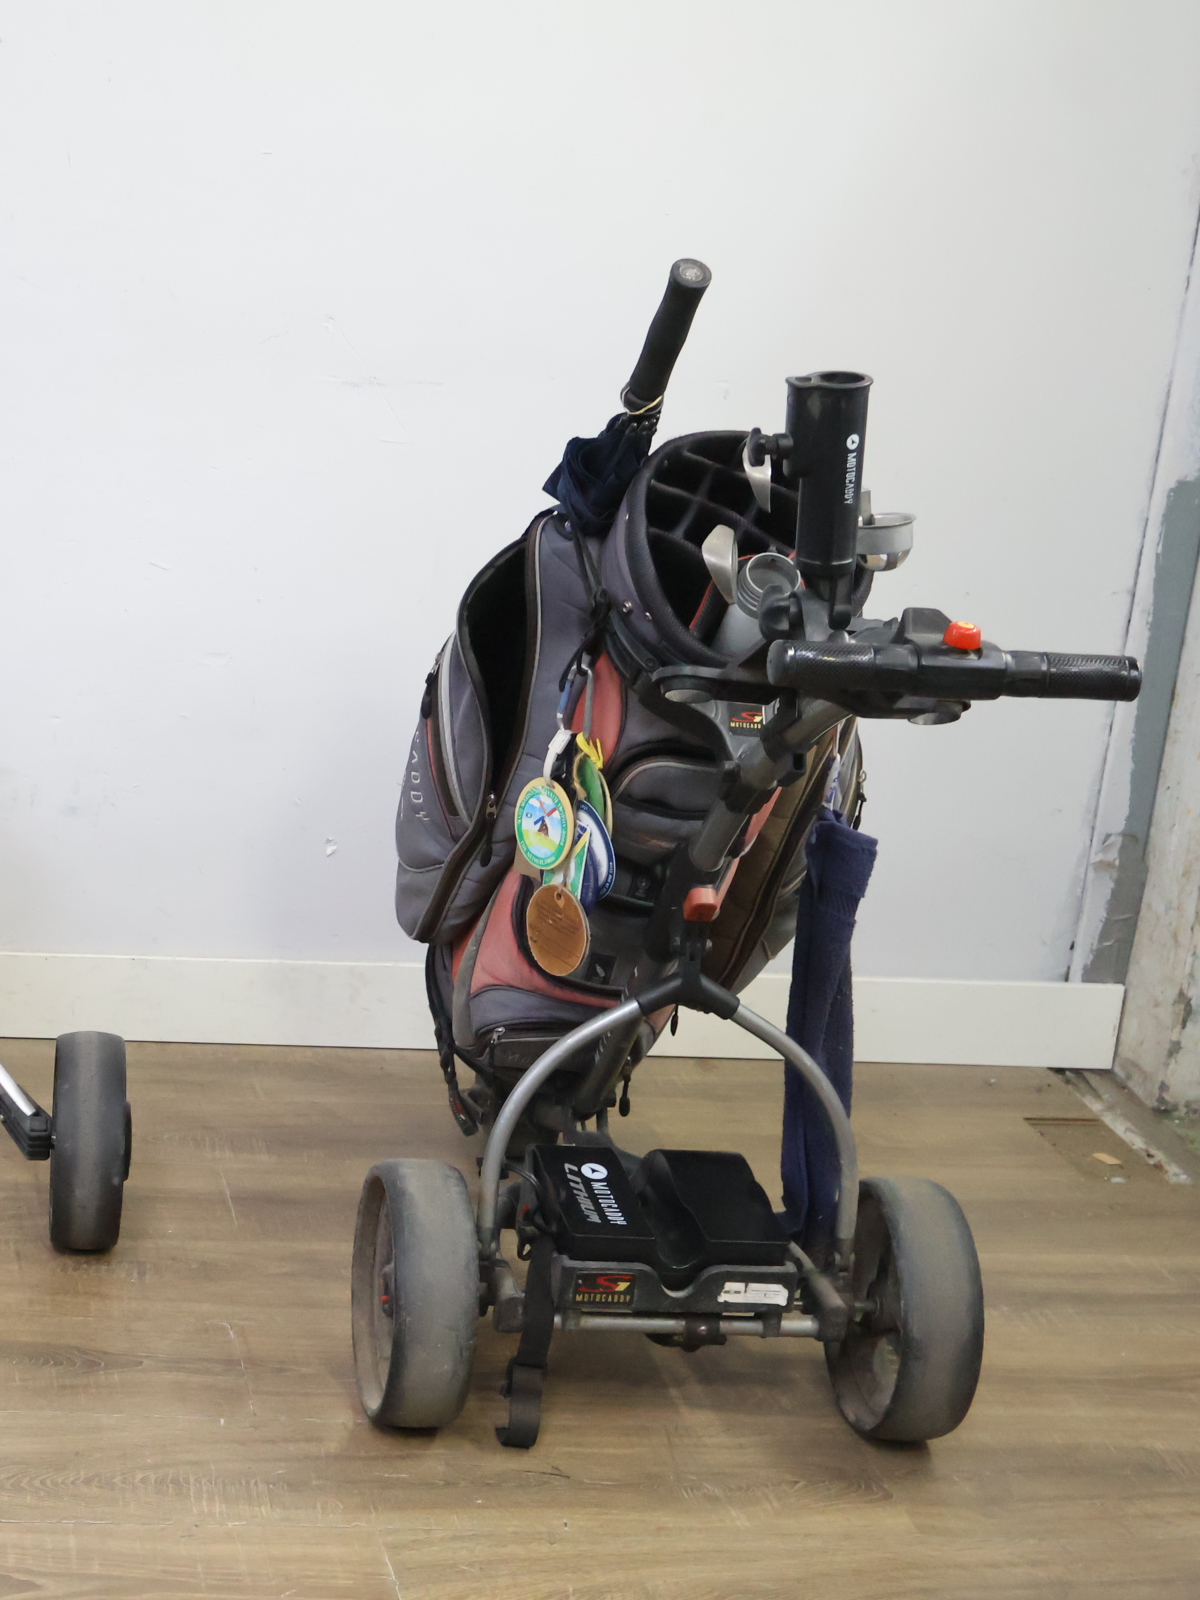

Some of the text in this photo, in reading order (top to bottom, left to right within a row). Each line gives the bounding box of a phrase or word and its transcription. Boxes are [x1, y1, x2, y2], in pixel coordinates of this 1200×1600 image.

[844, 452, 857, 504] MOTOCADDY
[564, 1163, 601, 1223] LITHIUM
[590, 1181, 627, 1225] MOTOCADDY
[576, 1294, 630, 1302] MOTOCADDY
